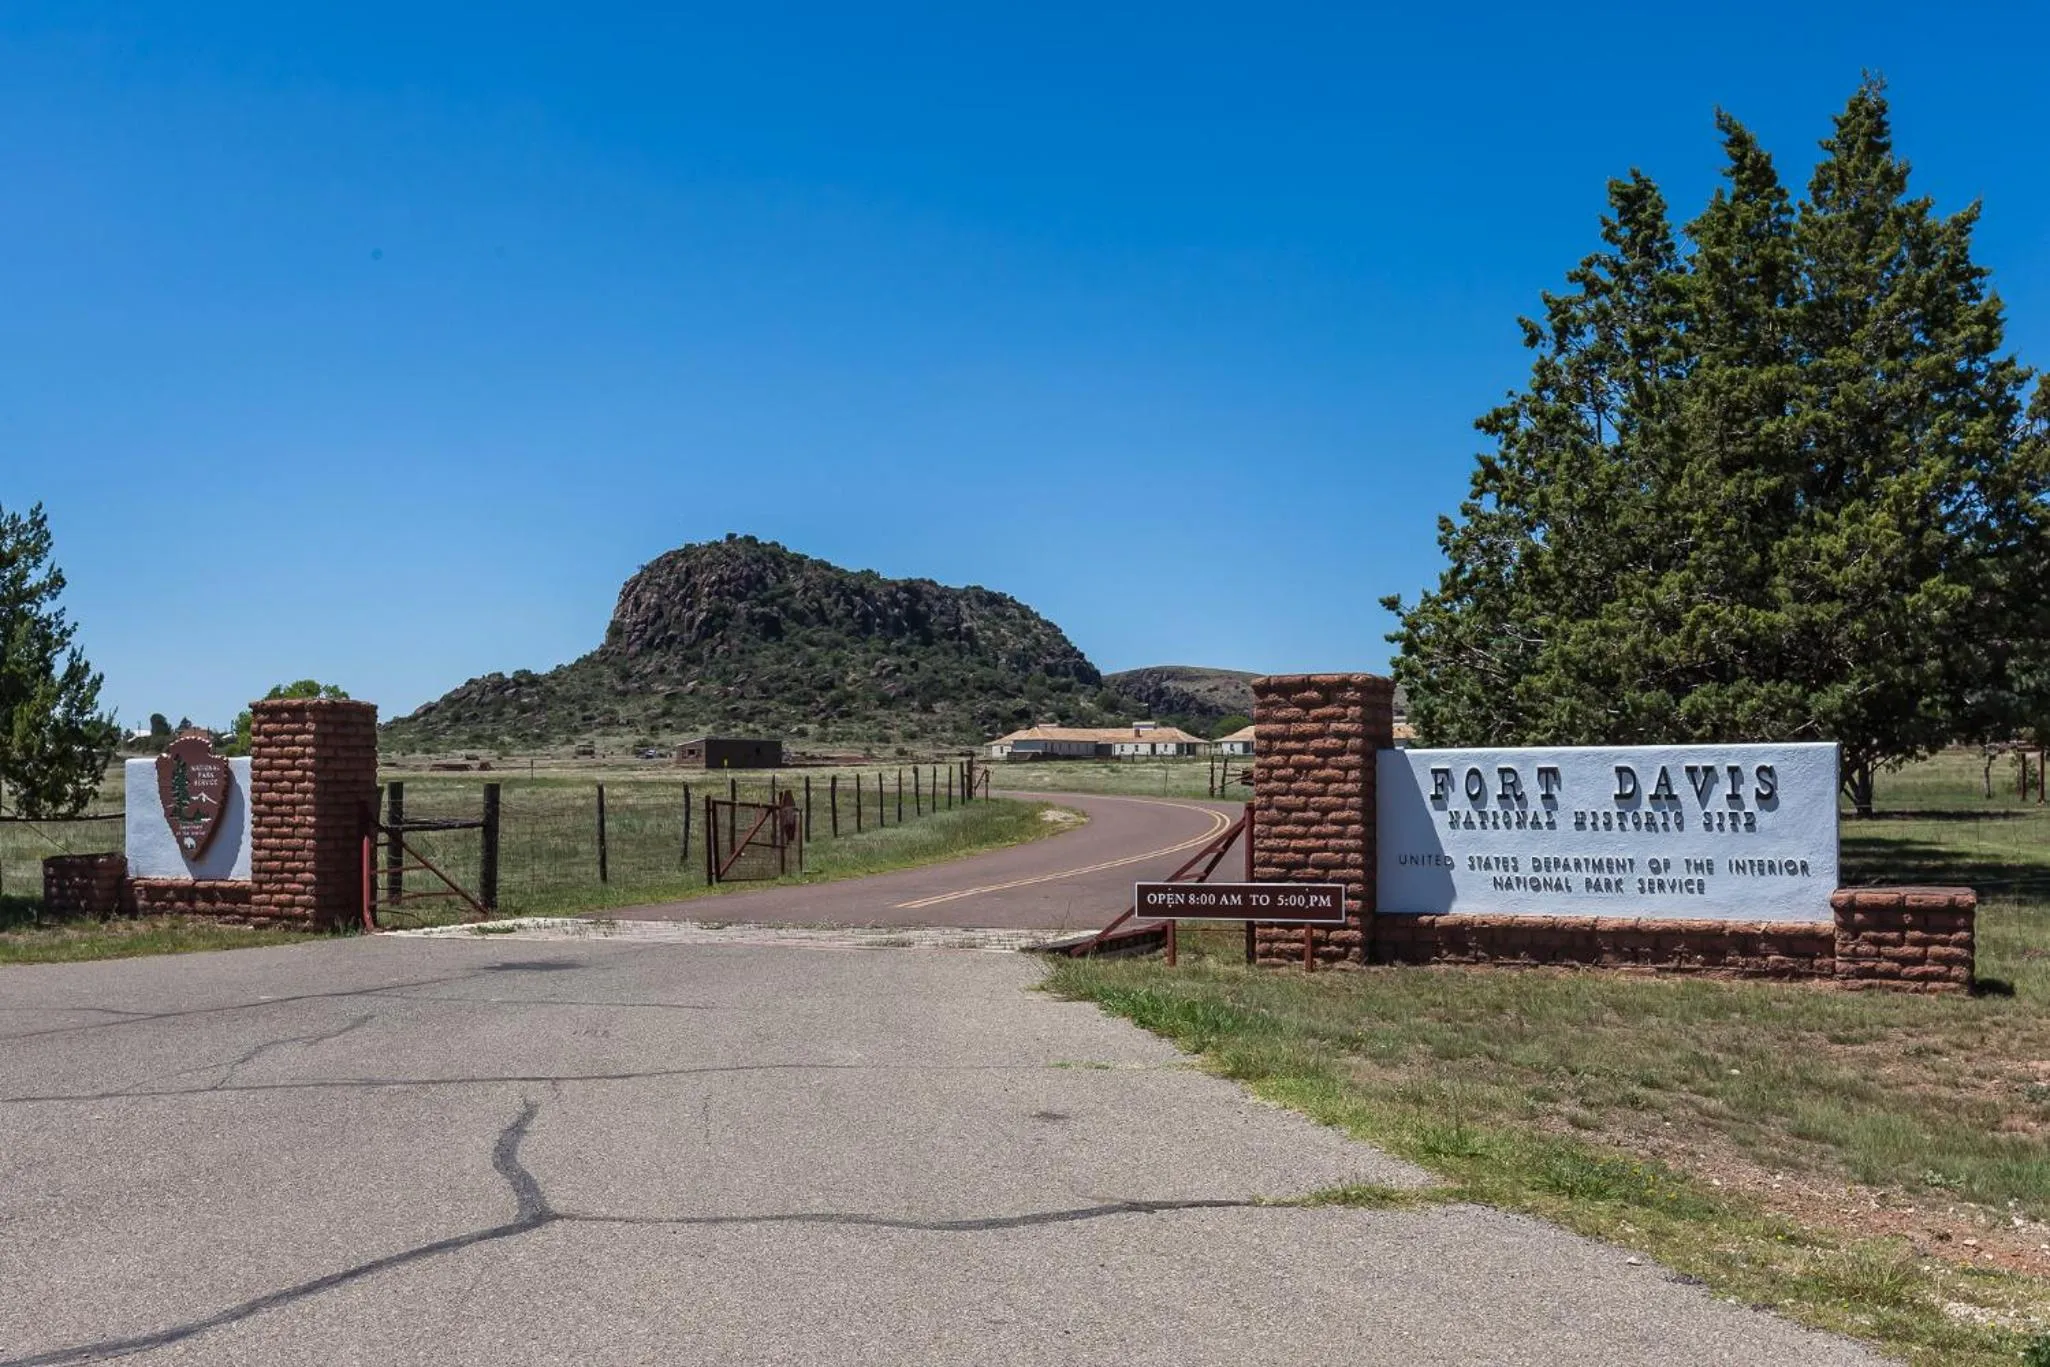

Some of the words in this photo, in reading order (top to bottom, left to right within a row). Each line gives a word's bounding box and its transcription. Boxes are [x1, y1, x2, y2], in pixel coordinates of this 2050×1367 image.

[1430, 767, 1562, 801] FORT
[1613, 765, 1777, 802] DAVIS
[1449, 811, 1556, 829] NATIONAL
[1574, 811, 1684, 831] HISTORIC
[1703, 812, 1756, 831] SITE
[1400, 856, 1454, 870] UNITED
[1468, 856, 1518, 872] STATES
[1532, 857, 1635, 873] DEPARTMENT
[1648, 858, 1670, 874] OF
[1685, 859, 1714, 875] THE
[1729, 859, 1810, 876] INTERIOR
[1494, 877, 1571, 892] NATIONAL
[1585, 878, 1623, 893] PARK
[1638, 878, 1704, 894] SERVICE
[1147, 893, 1185, 904] OPEN
[1188, 893, 1215, 905] 8:00
[1219, 894, 1243, 905] AM
[1250, 895, 1270, 905] TO
[1277, 895, 1305, 906] 5:00
[1309, 895, 1332, 907] PM
